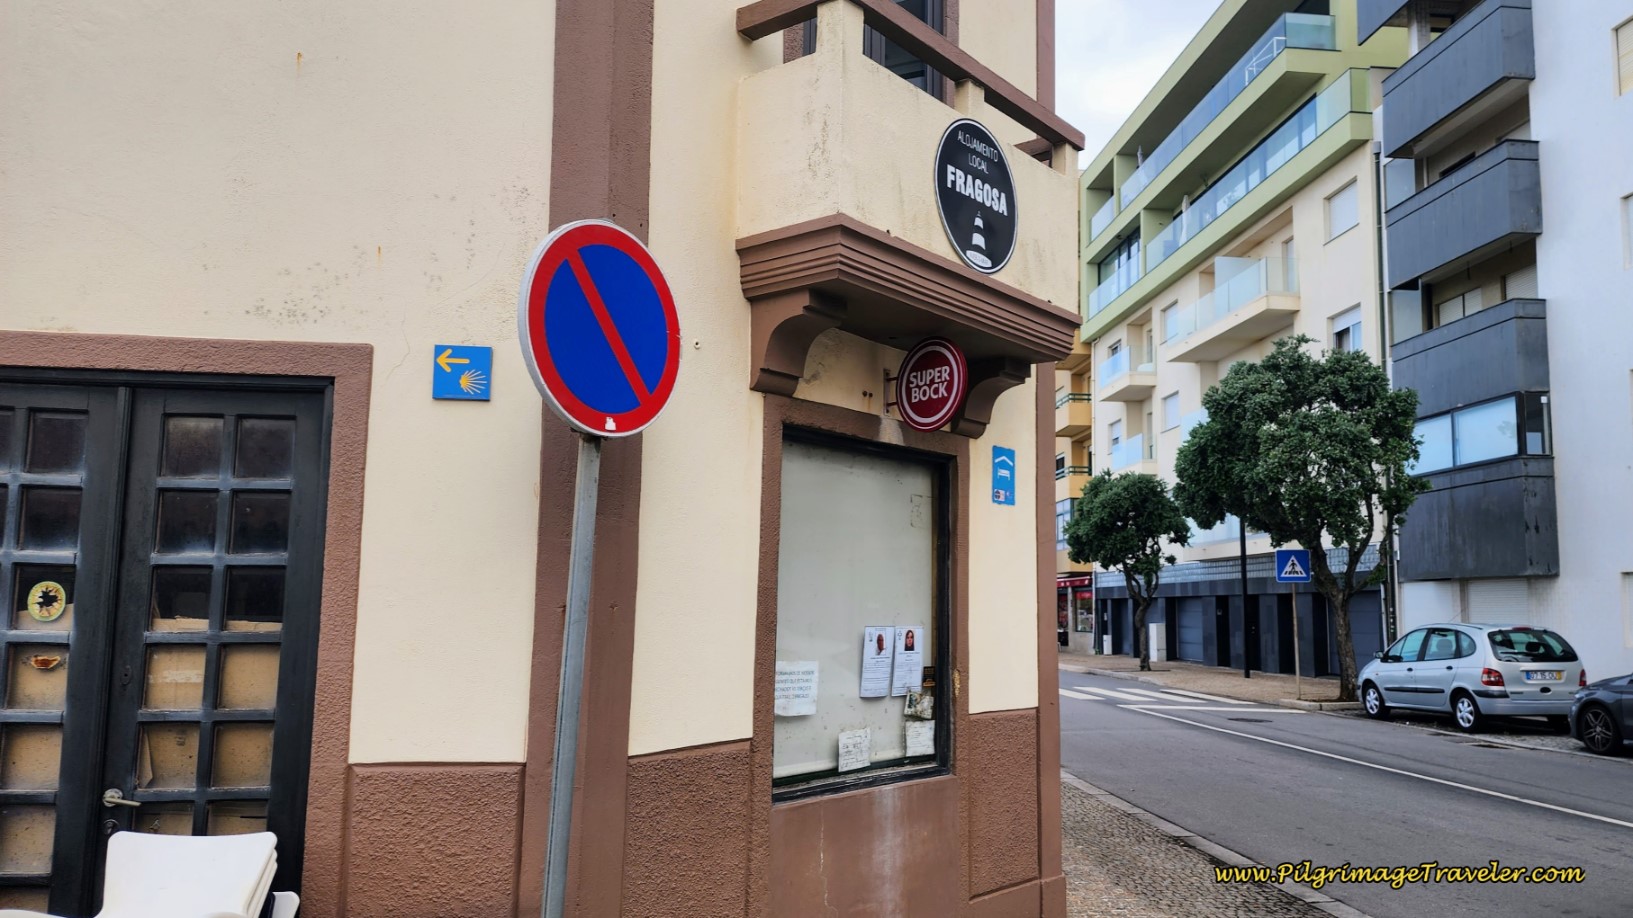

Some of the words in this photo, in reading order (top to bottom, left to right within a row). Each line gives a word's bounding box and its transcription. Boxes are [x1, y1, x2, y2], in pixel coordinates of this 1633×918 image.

[957, 130, 999, 162] ALOJAMENTO
[968, 153, 989, 174] LOCAL
[946, 164, 1008, 216] FRAGOSA
[909, 365, 950, 388] SUPER
[911, 381, 948, 403] BOCK
